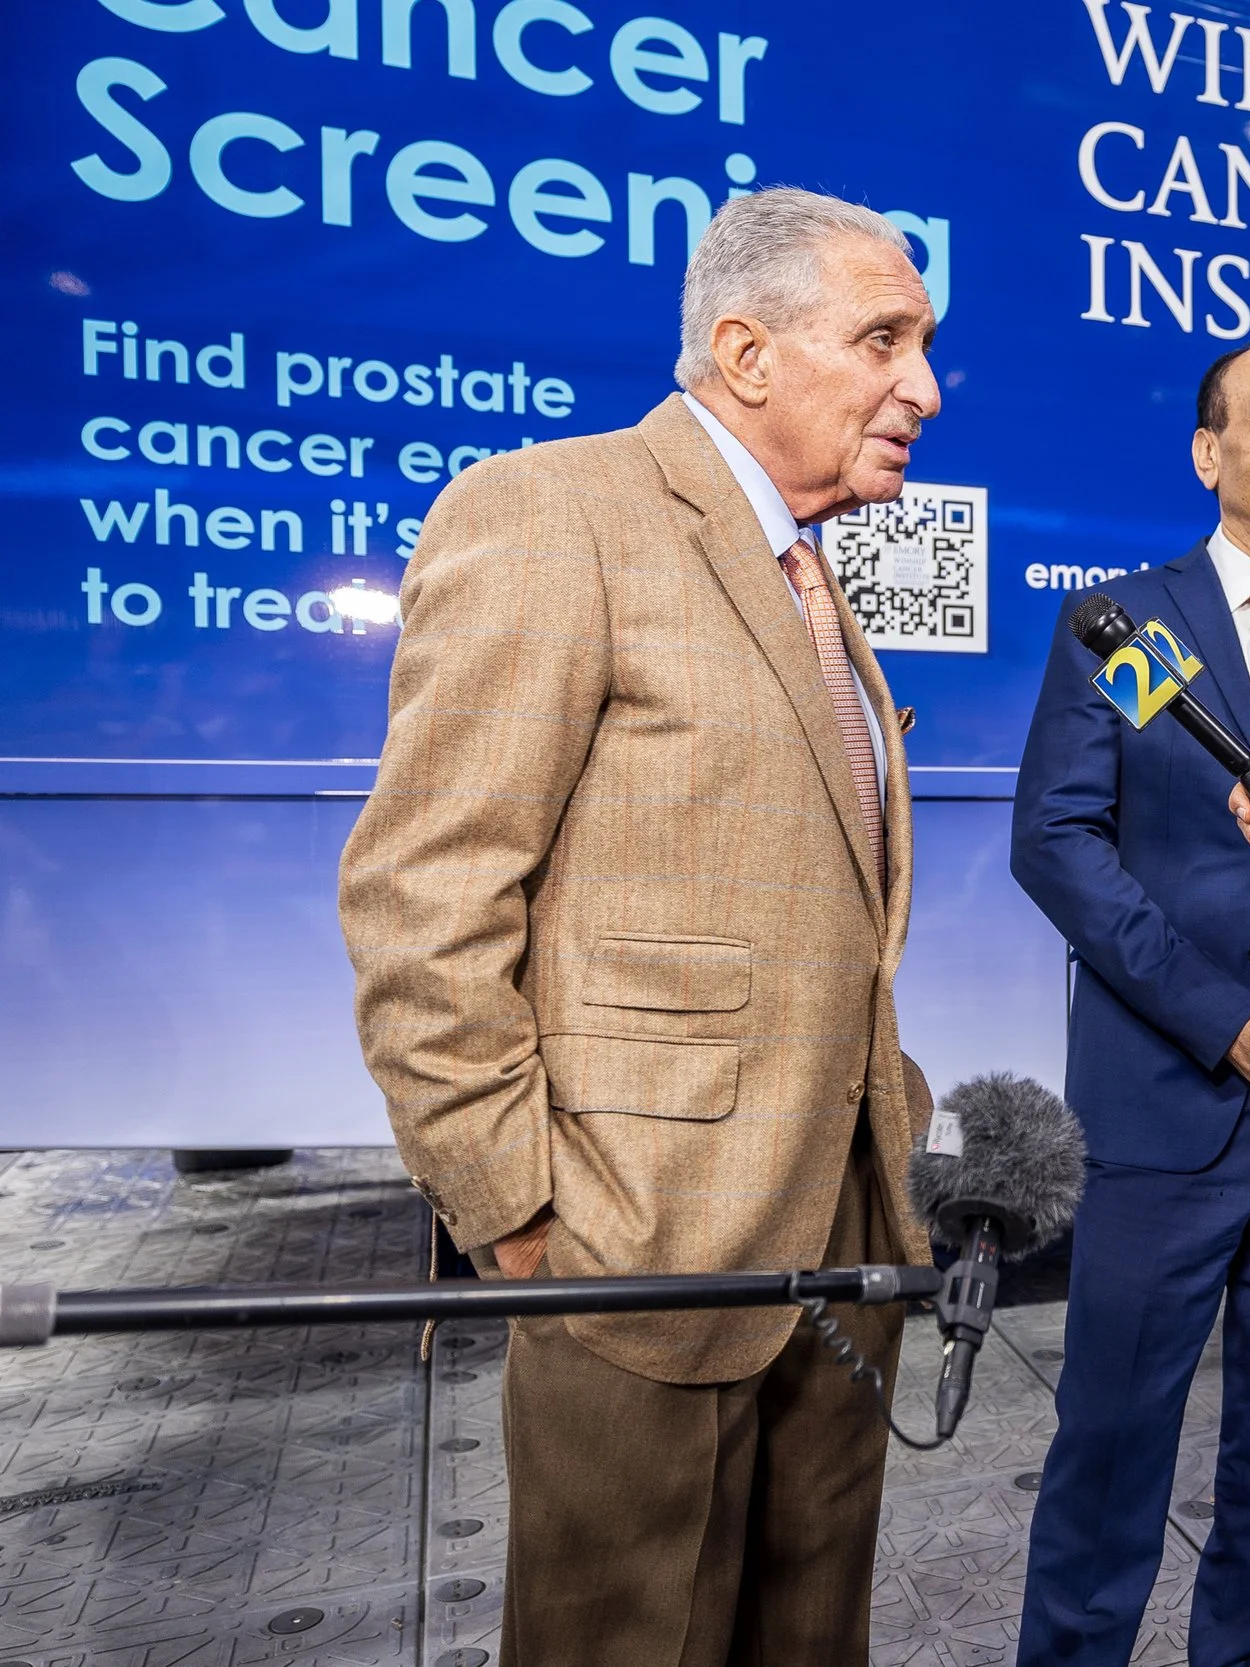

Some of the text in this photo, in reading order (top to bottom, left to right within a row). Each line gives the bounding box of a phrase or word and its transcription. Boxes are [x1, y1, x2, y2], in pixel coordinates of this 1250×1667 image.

[98, 0, 768, 125] ancer
[83, 319, 575, 418] Find prostate
[81, 417, 374, 478] cancer
[80, 488, 303, 552] when
[81, 567, 162, 628] to
[1141, 619, 1204, 683] 2
[1105, 646, 1181, 729] 2
